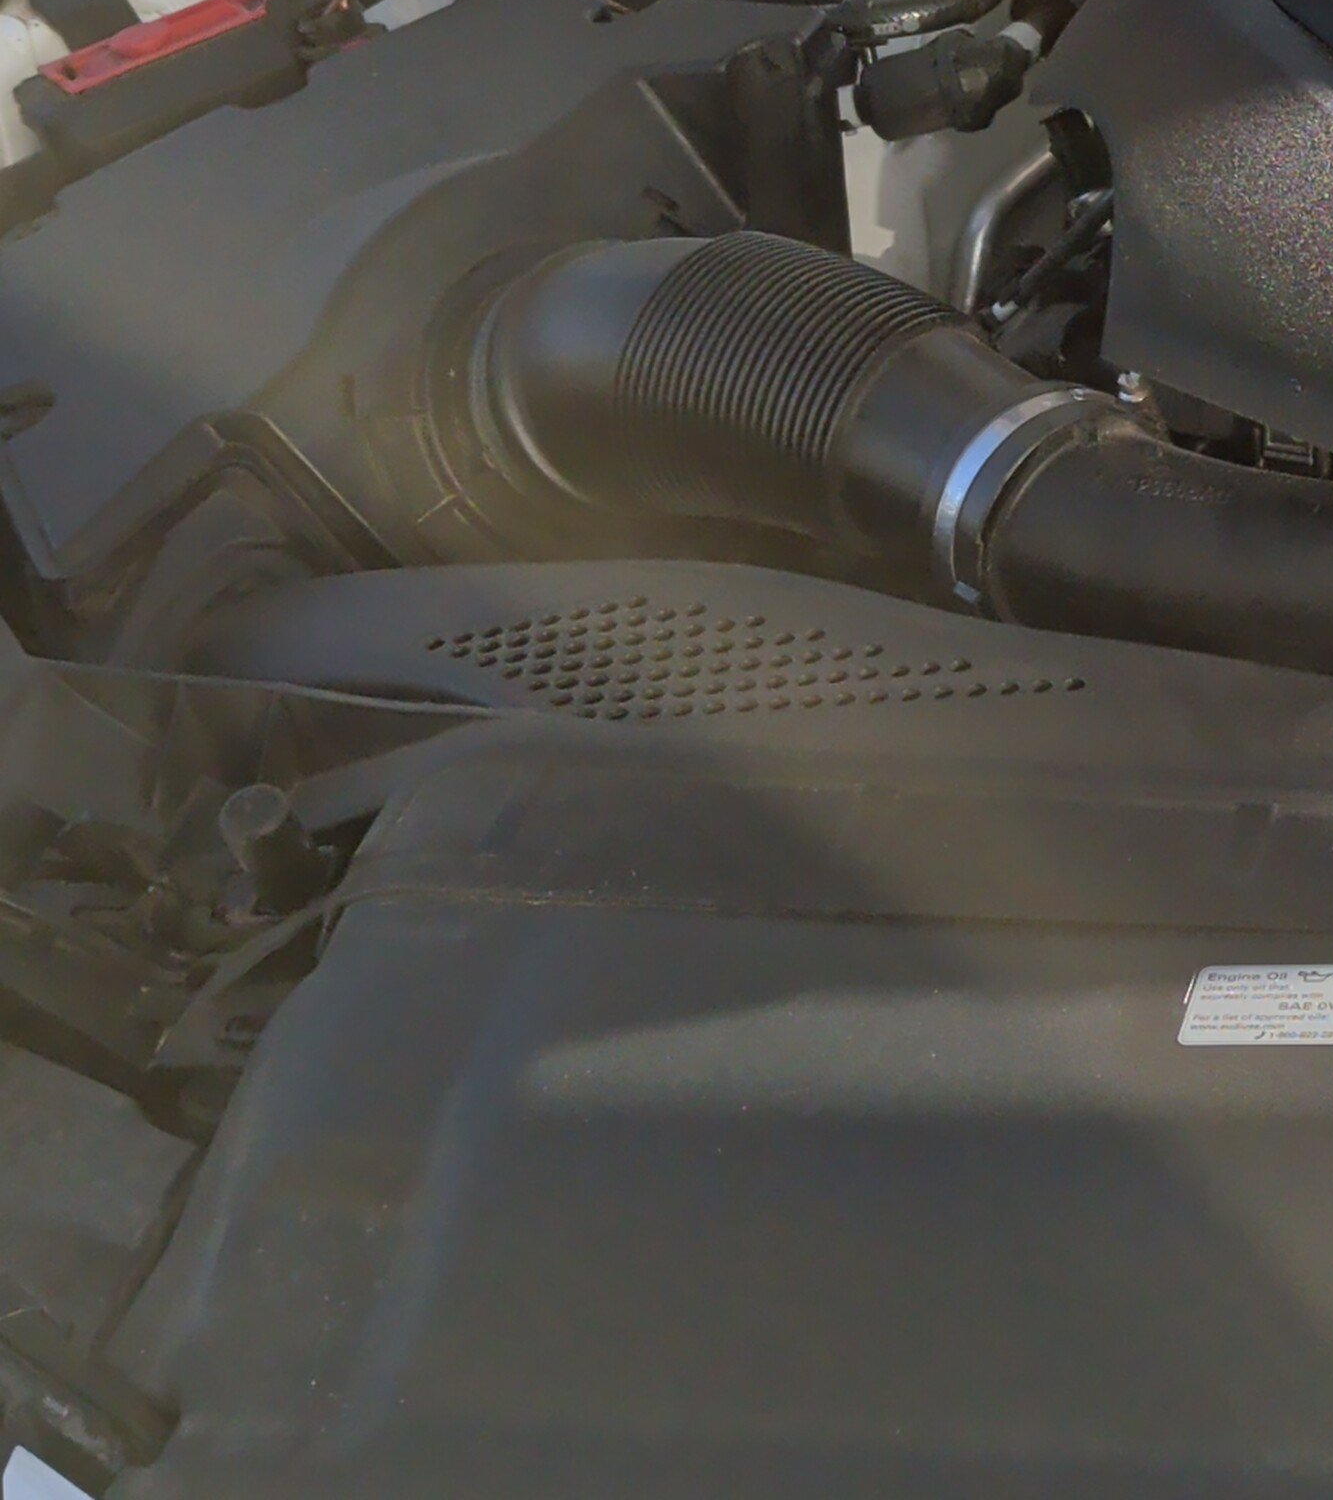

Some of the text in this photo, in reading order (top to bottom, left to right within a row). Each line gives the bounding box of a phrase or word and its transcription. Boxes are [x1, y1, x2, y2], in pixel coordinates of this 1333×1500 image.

[1208, 971, 1288, 982] Engine Oil
[1279, 1001, 1313, 1011] SAE
